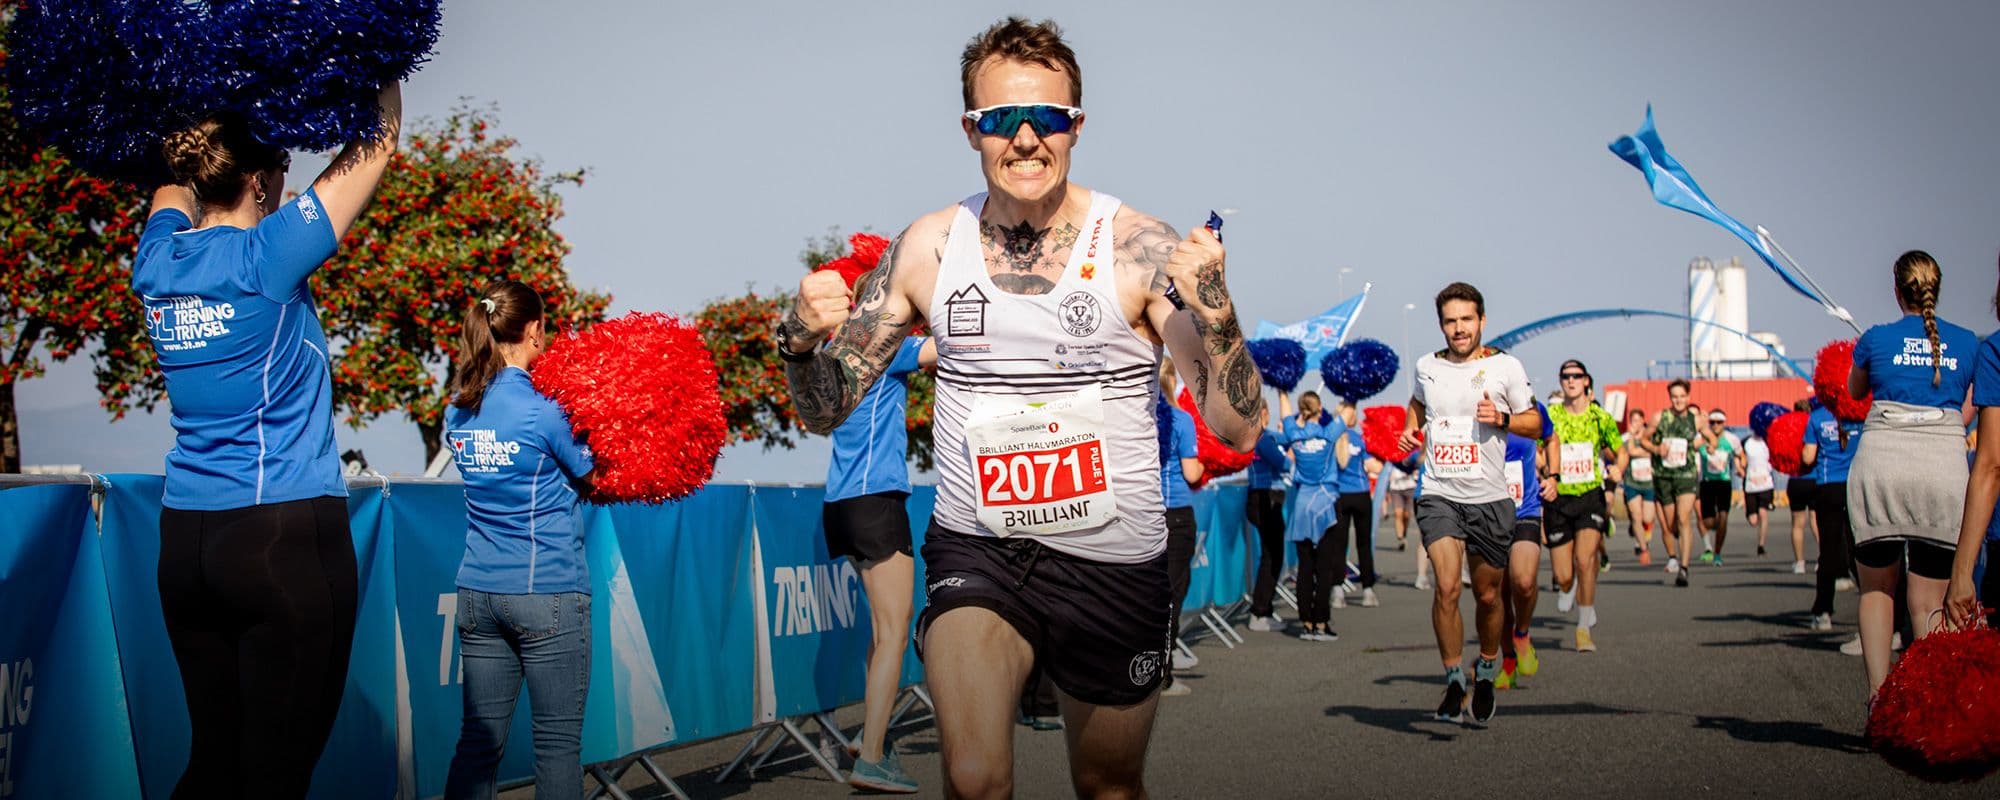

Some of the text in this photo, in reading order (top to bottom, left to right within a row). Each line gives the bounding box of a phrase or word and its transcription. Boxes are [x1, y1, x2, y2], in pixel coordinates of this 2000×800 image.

[1087, 217, 1104, 258] EXTRA
[174, 295, 203, 310] TRIM
[174, 303, 235, 325] TRENING
[174, 320, 230, 341] TRIVSEL
[163, 341, 208, 351] www.3t.no
[1893, 353, 1958, 371] #3ttreing
[473, 430, 496, 442] TRIM
[1010, 424, 1047, 434] SpareBank
[473, 441, 521, 455] TRENING
[979, 432, 1096, 455] BRILLIANT HALVMARATON
[473, 453, 515, 467] TRIVSEL
[1089, 446, 1103, 478] PULJE
[1435, 446, 1473, 464] 2286
[983, 447, 1084, 502] 2071
[1001, 500, 1091, 528] BRILLIANT
